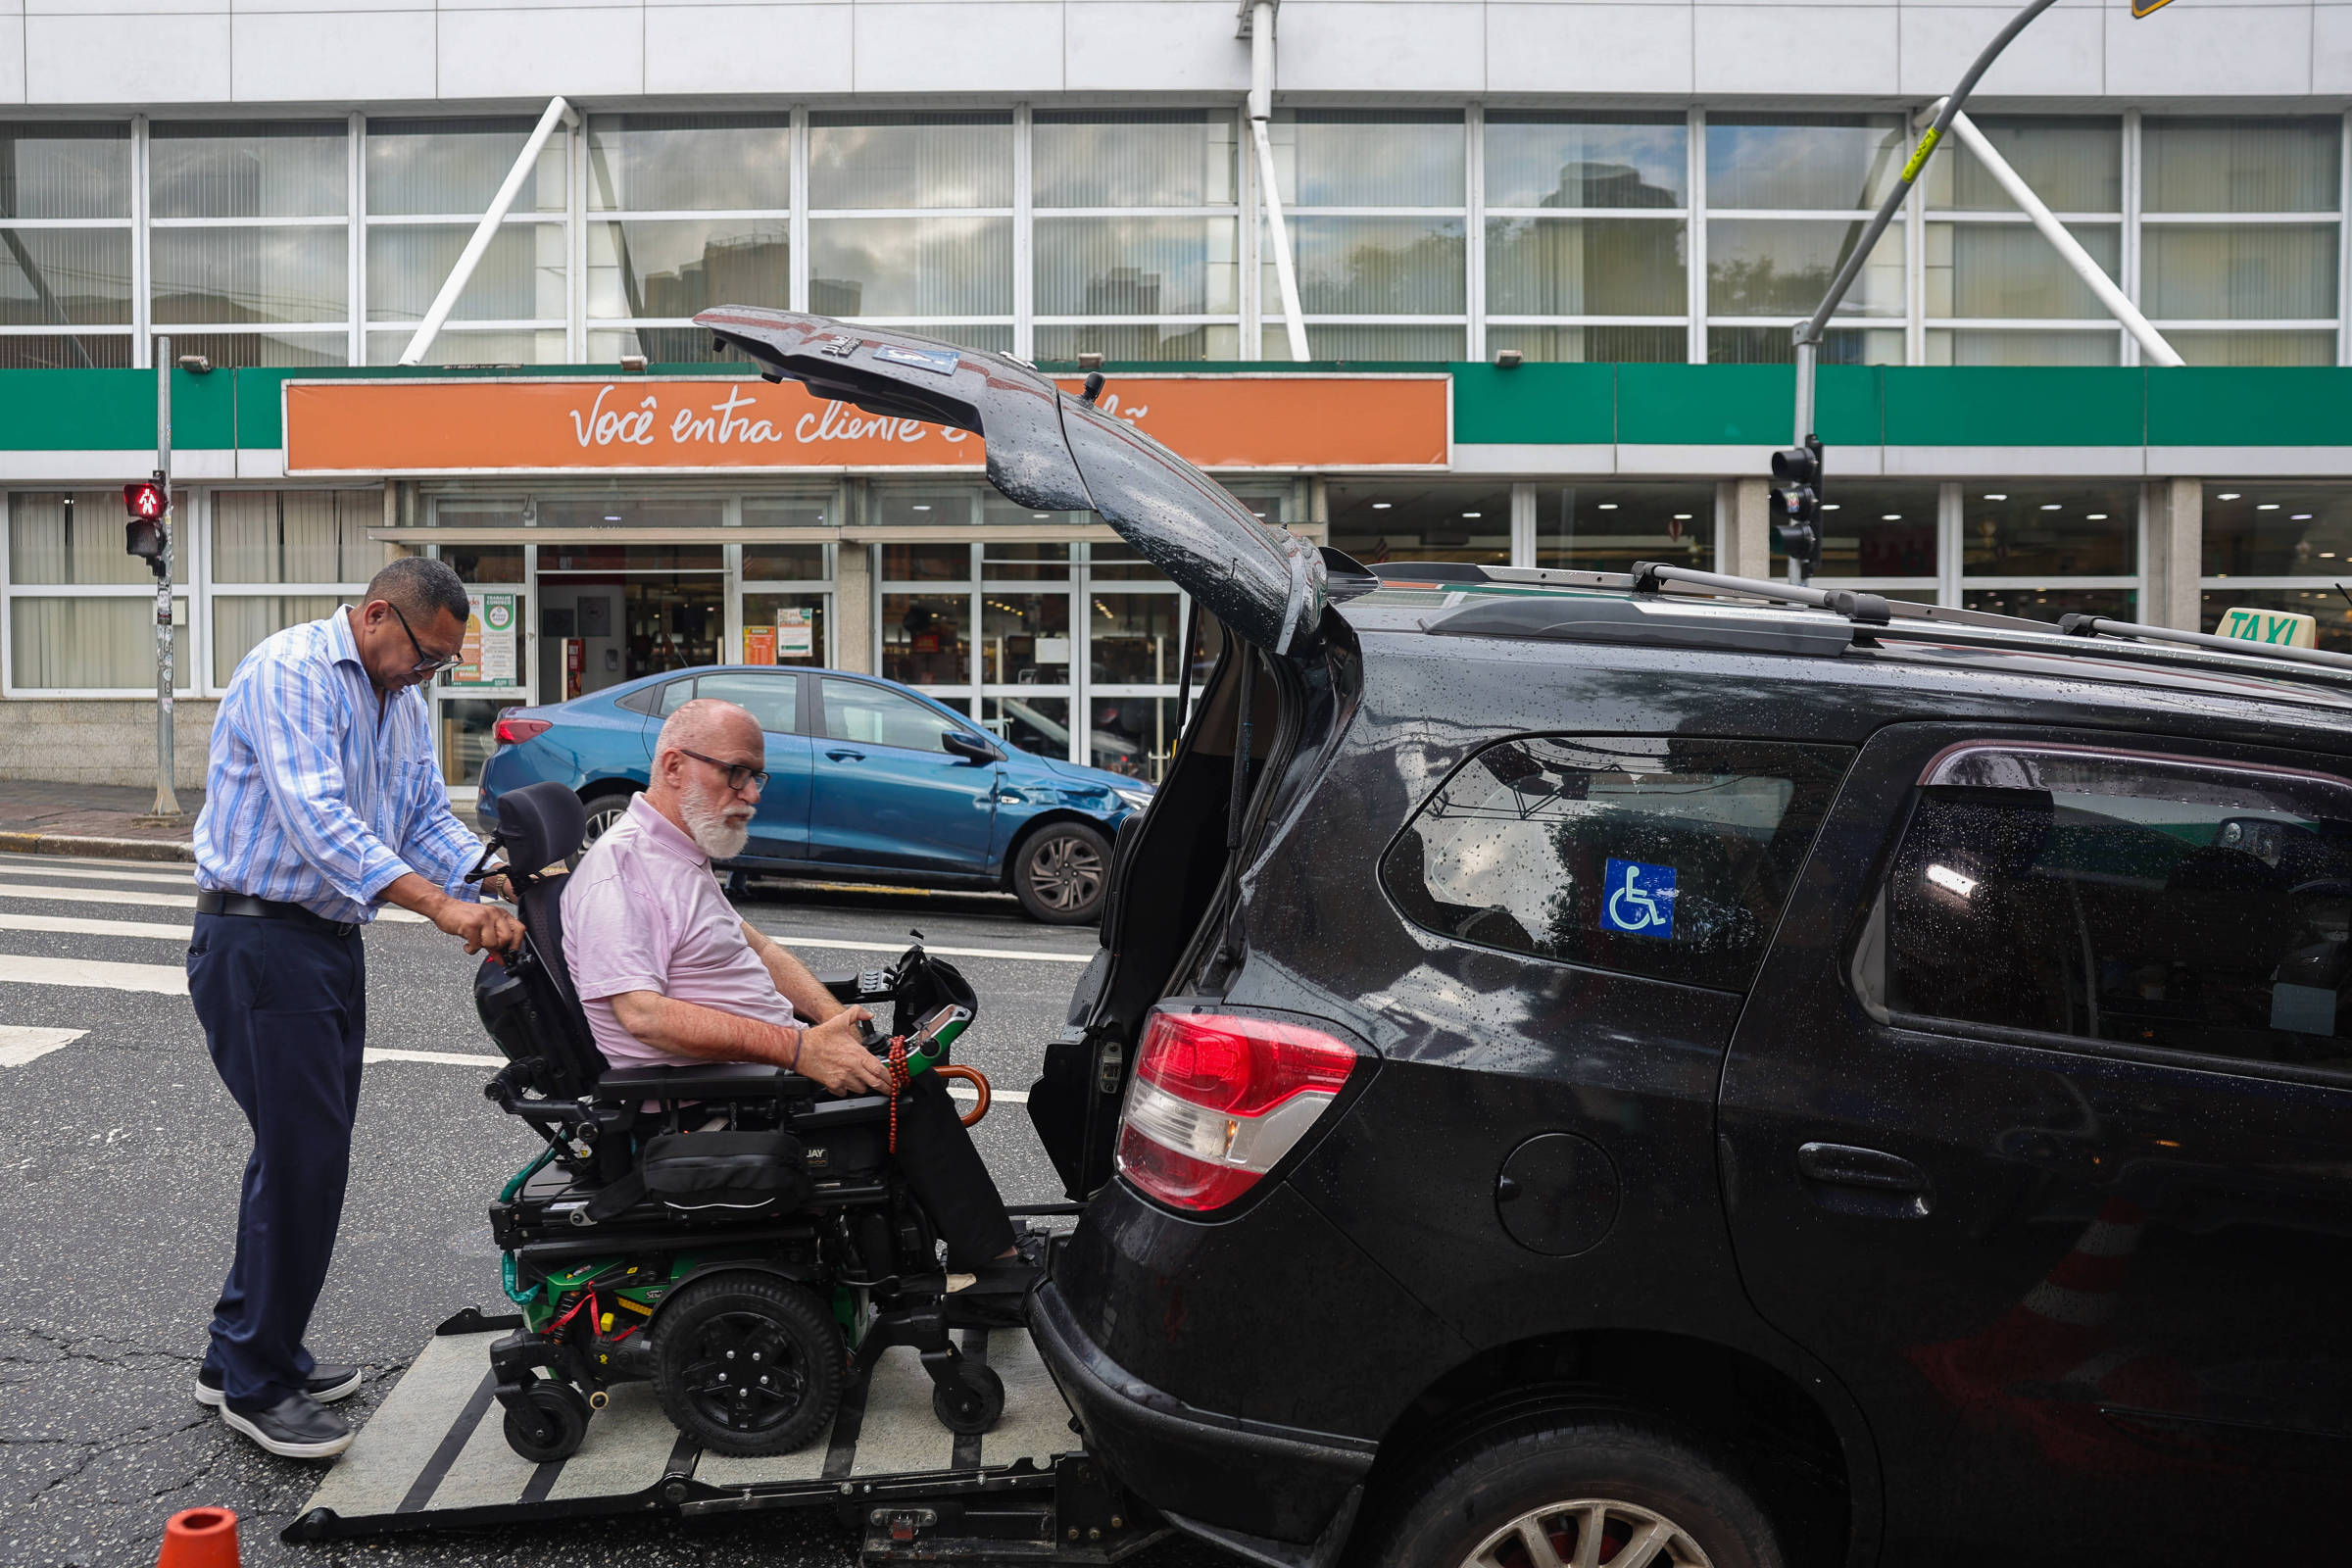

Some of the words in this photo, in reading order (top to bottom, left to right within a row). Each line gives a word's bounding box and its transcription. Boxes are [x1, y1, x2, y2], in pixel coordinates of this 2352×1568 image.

[569, 384, 655, 447] Você
[669, 384, 783, 444] entra
[2230, 612, 2297, 646] TAXI
[807, 1149, 825, 1158] JAY
